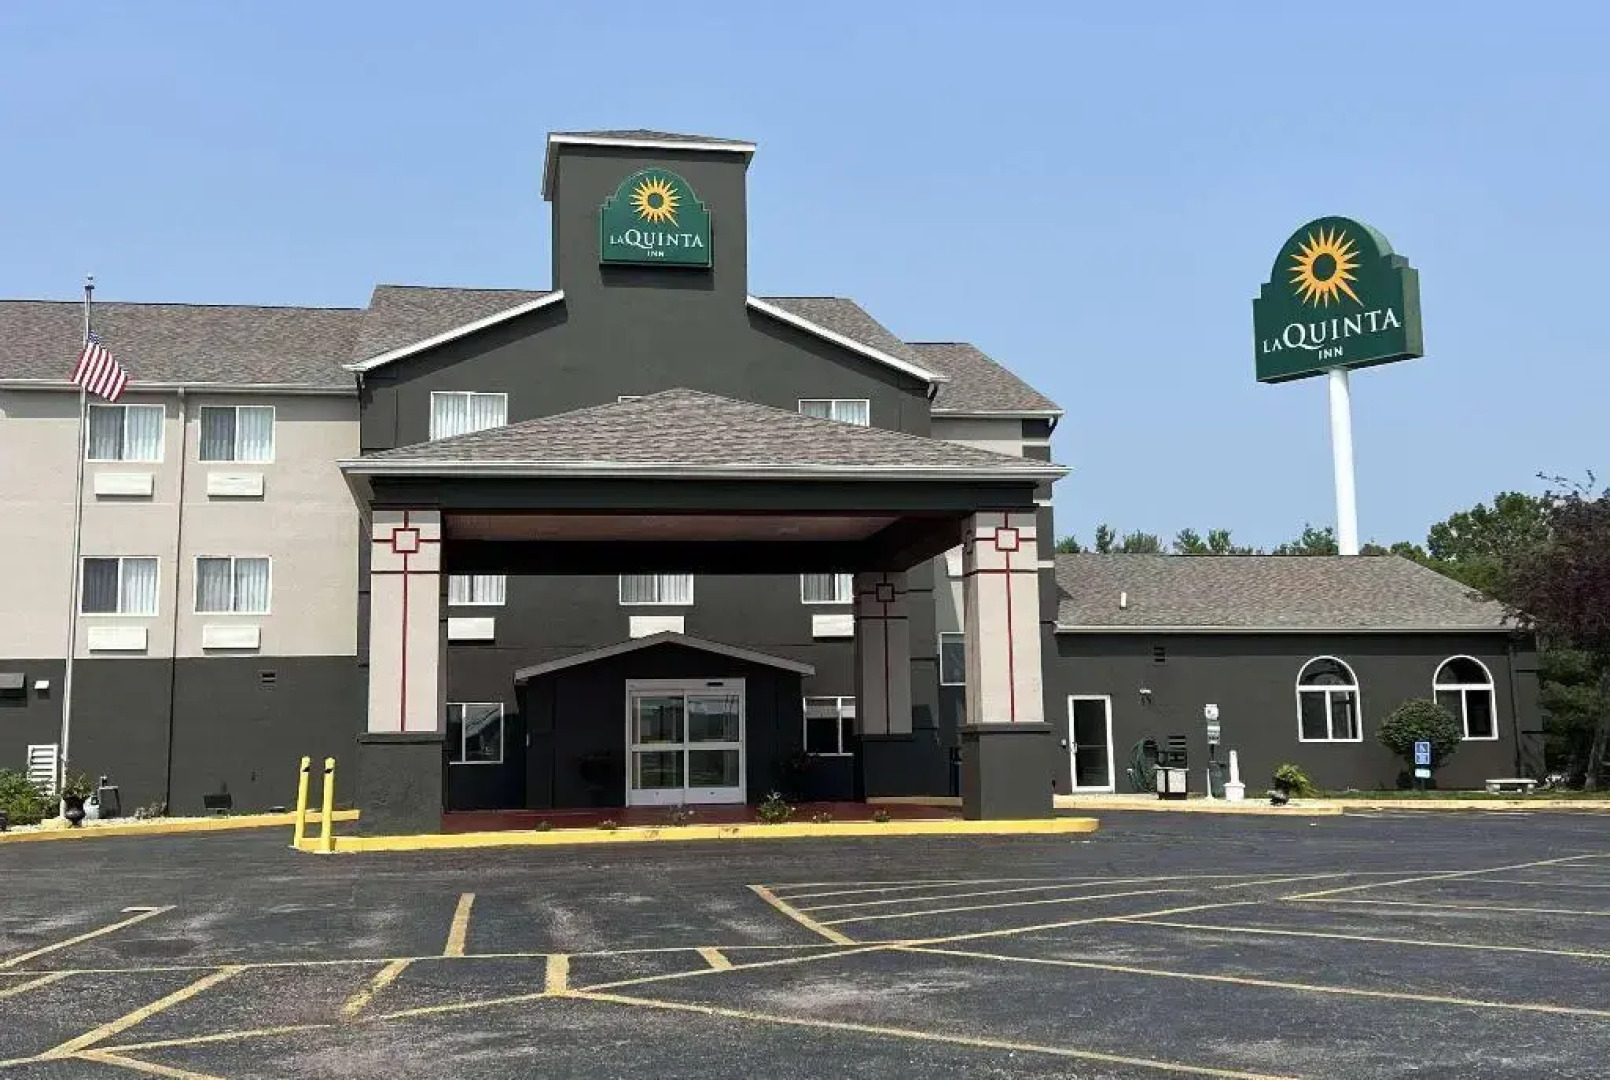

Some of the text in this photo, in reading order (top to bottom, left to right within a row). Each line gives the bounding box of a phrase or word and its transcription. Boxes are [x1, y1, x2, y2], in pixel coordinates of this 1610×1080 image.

[625, 229, 704, 249] QUINTA
[1283, 308, 1401, 350] QUINTA
[1319, 346, 1343, 361] INN
